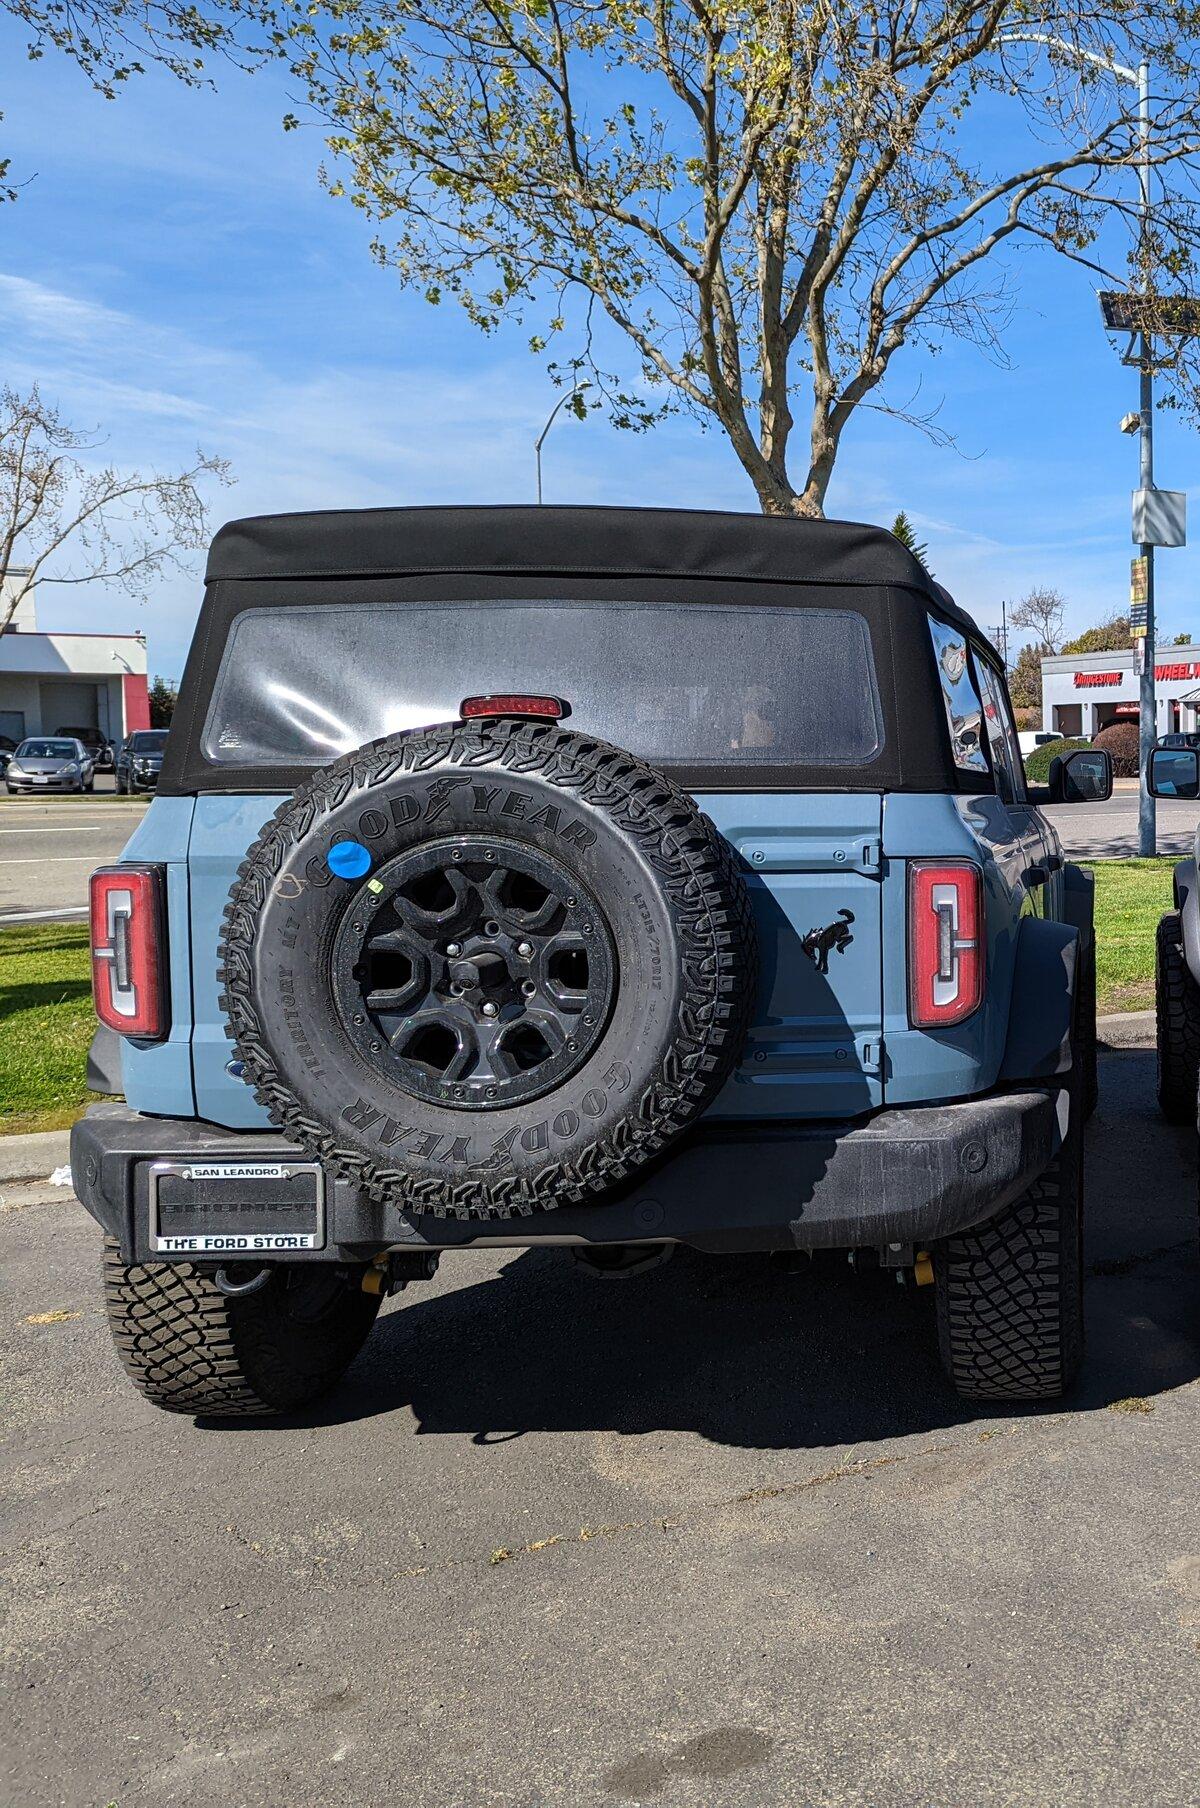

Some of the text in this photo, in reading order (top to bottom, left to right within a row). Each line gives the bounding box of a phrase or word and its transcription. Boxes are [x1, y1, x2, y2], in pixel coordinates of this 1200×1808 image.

[1155, 662, 1193, 681] WHEEL
[470, 782, 599, 854] YEAR
[194, 1168, 279, 1177] SAN LEANDRO
[164, 1236, 309, 1250] THE FORD STORE
